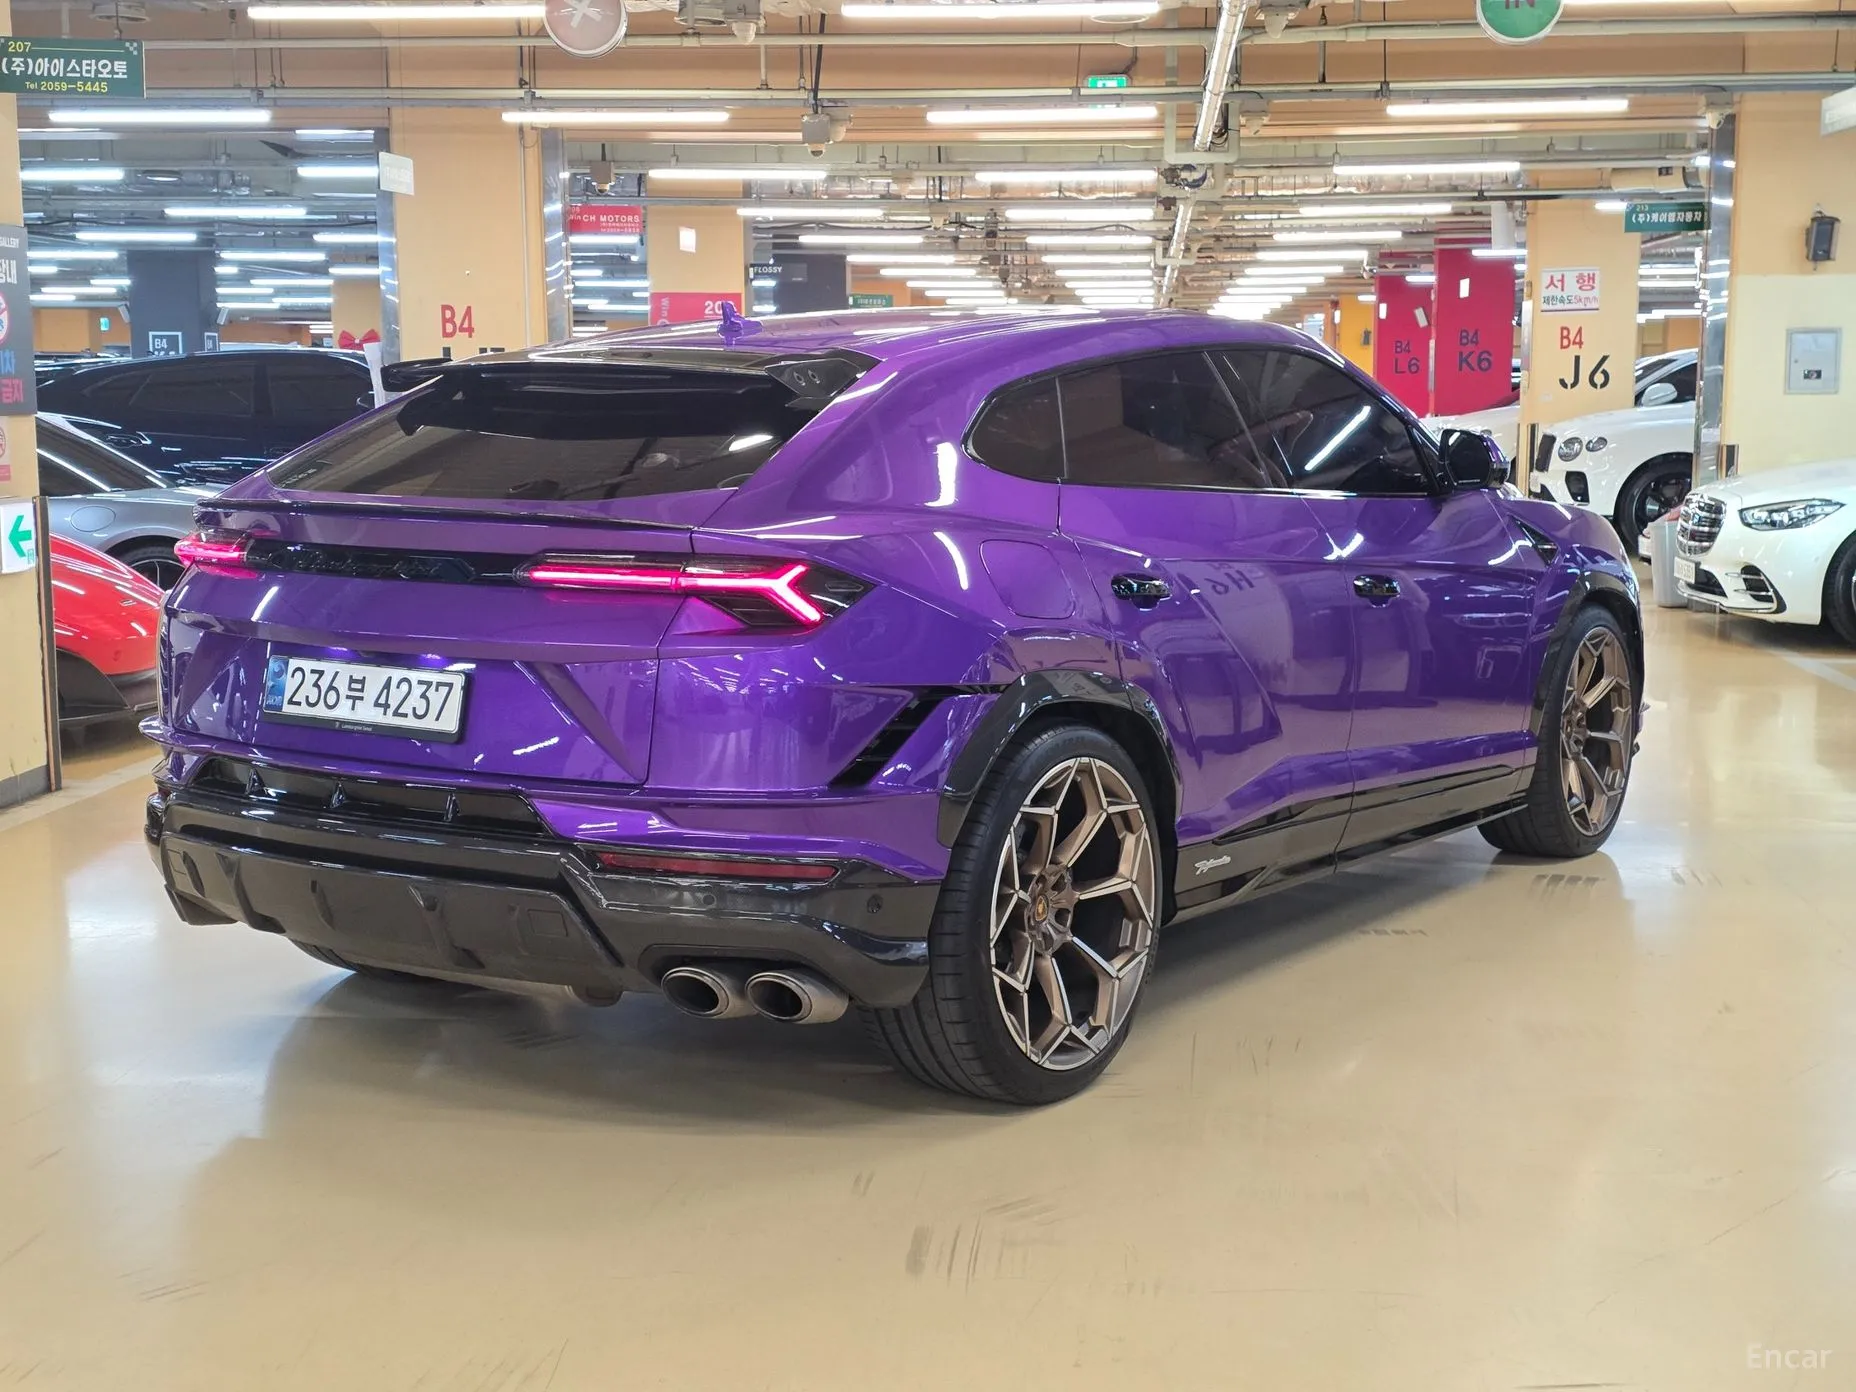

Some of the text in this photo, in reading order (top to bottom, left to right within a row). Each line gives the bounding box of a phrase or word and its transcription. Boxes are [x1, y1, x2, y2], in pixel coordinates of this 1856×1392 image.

[8, 41, 31, 53] 207
[1, 57, 128, 79] (주)아이스타오토
[40, 81, 108, 93] 2059-5445
[599, 214, 640, 222] MOTORS
[753, 266, 783, 274] FLOSSY
[440, 303, 475, 339] B4
[154, 338, 168, 349] B4
[1459, 328, 1479, 346] B4
[1559, 325, 1584, 350] B4
[1394, 340, 1412, 354] B4
[1394, 357, 1420, 375] L6
[1457, 350, 1493, 372] K6
[1558, 354, 1611, 390] J6
[287, 666, 454, 722] 236부 4237
